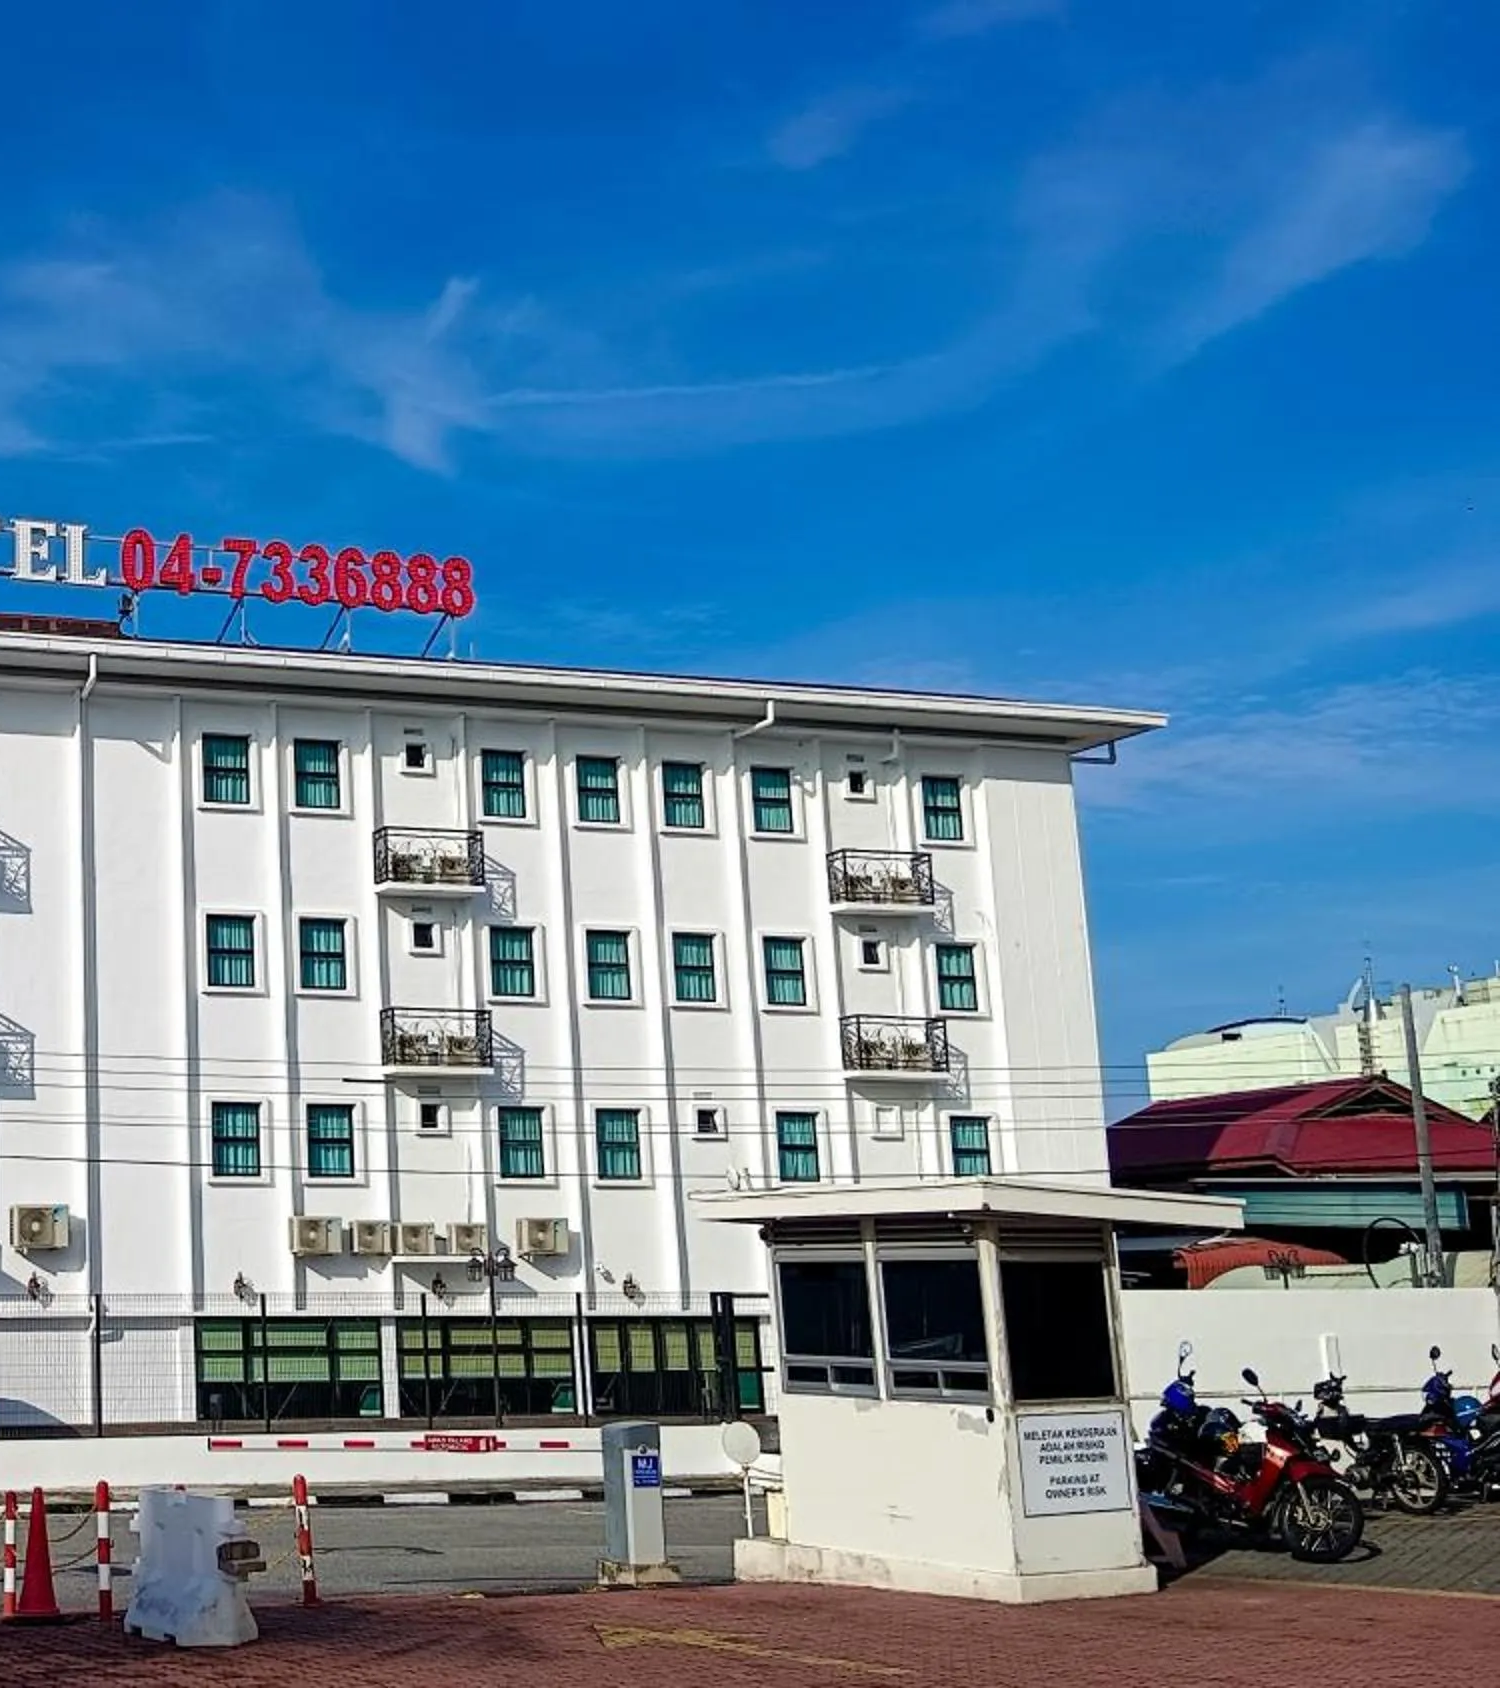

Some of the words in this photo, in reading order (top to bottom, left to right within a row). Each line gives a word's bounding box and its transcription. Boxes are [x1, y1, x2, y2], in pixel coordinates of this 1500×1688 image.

[120, 528, 475, 618] 04-7336888
[1023, 1429, 1064, 1441] MELETAK
[1065, 1427, 1117, 1439] KENDERAAN
[1040, 1442, 1075, 1453] ADALAH
[1039, 1454, 1073, 1465] PEMILIK
[1049, 1474, 1088, 1486] PARKING
[1089, 1473, 1101, 1483] AT
[1086, 1486, 1107, 1496] RISK
